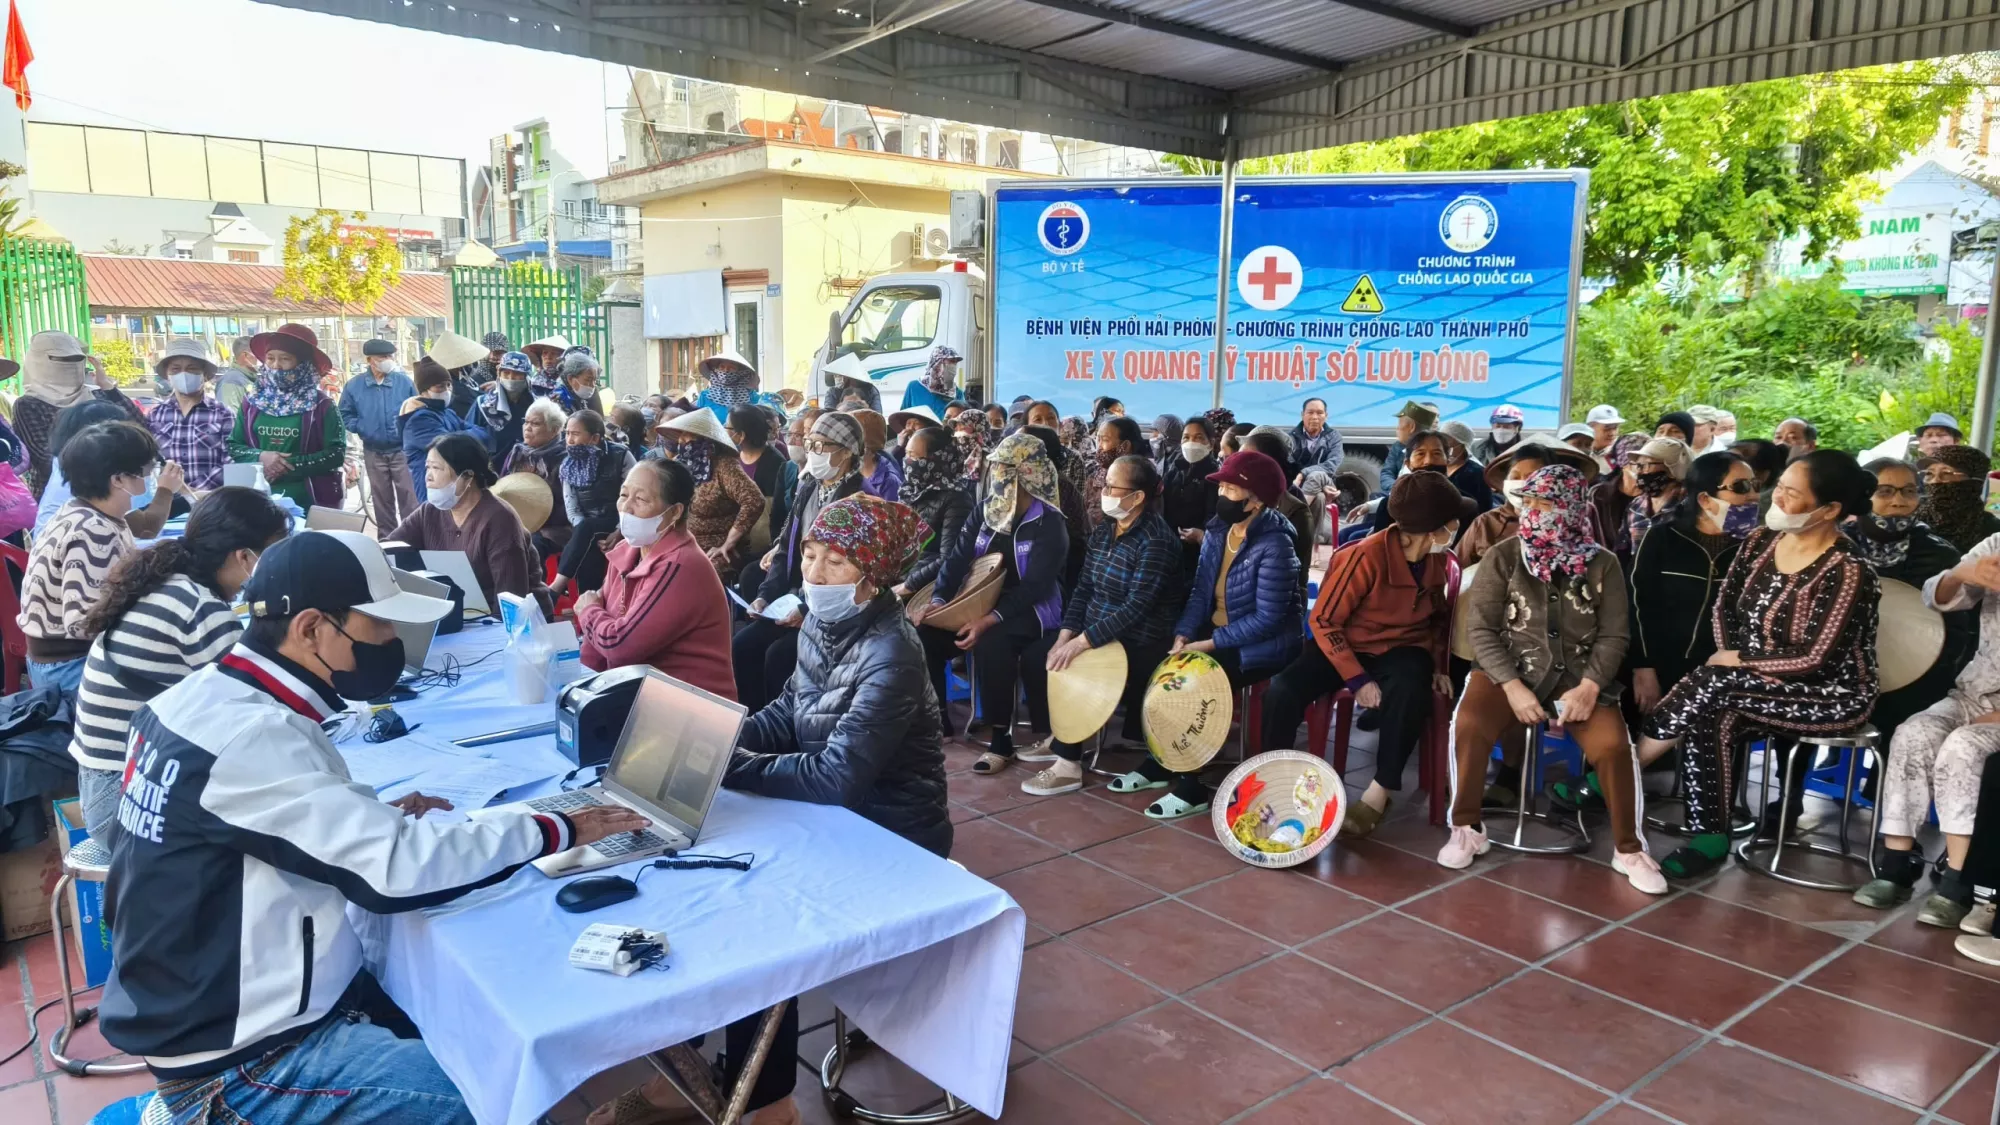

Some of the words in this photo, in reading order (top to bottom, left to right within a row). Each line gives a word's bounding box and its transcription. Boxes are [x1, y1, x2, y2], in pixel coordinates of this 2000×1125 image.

[1869, 216, 1921, 236] NAM
[1042, 260, 1057, 275] BỘ
[1060, 262, 1069, 273] Y
[1070, 257, 1085, 273] TẾ
[1418, 255, 1471, 268] CHƯƠNG
[1474, 254, 1516, 267] TRÌNH
[1398, 269, 1442, 285] CHỐNG
[1445, 273, 1470, 285] LAO
[1473, 269, 1509, 286] QUỐC
[1511, 272, 1533, 285] GIA
[1026, 317, 1064, 340] BỆNH
[1070, 317, 1102, 340] VIỆN
[1107, 314, 1141, 336] PHỔI
[1145, 314, 1169, 336] HẢI
[1173, 316, 1217, 337] PHÒN
[1235, 319, 1295, 337] CHƯƠNG
[1301, 319, 1344, 338] TRÌNH
[1349, 316, 1401, 338] CHỐNG
[1405, 321, 1434, 338] LAO
[1441, 319, 1492, 338] THÀNH
[1499, 315, 1532, 338] PHỐ
[1065, 350, 1094, 380] XE
[1101, 350, 1116, 380] X
[1123, 350, 1201, 383] QUANG
[1245, 344, 1320, 389] THUẬT
[1326, 340, 1361, 382] SỐ
[1365, 347, 1413, 382] LƯU
[1419, 344, 1490, 389] ĐỘNG
